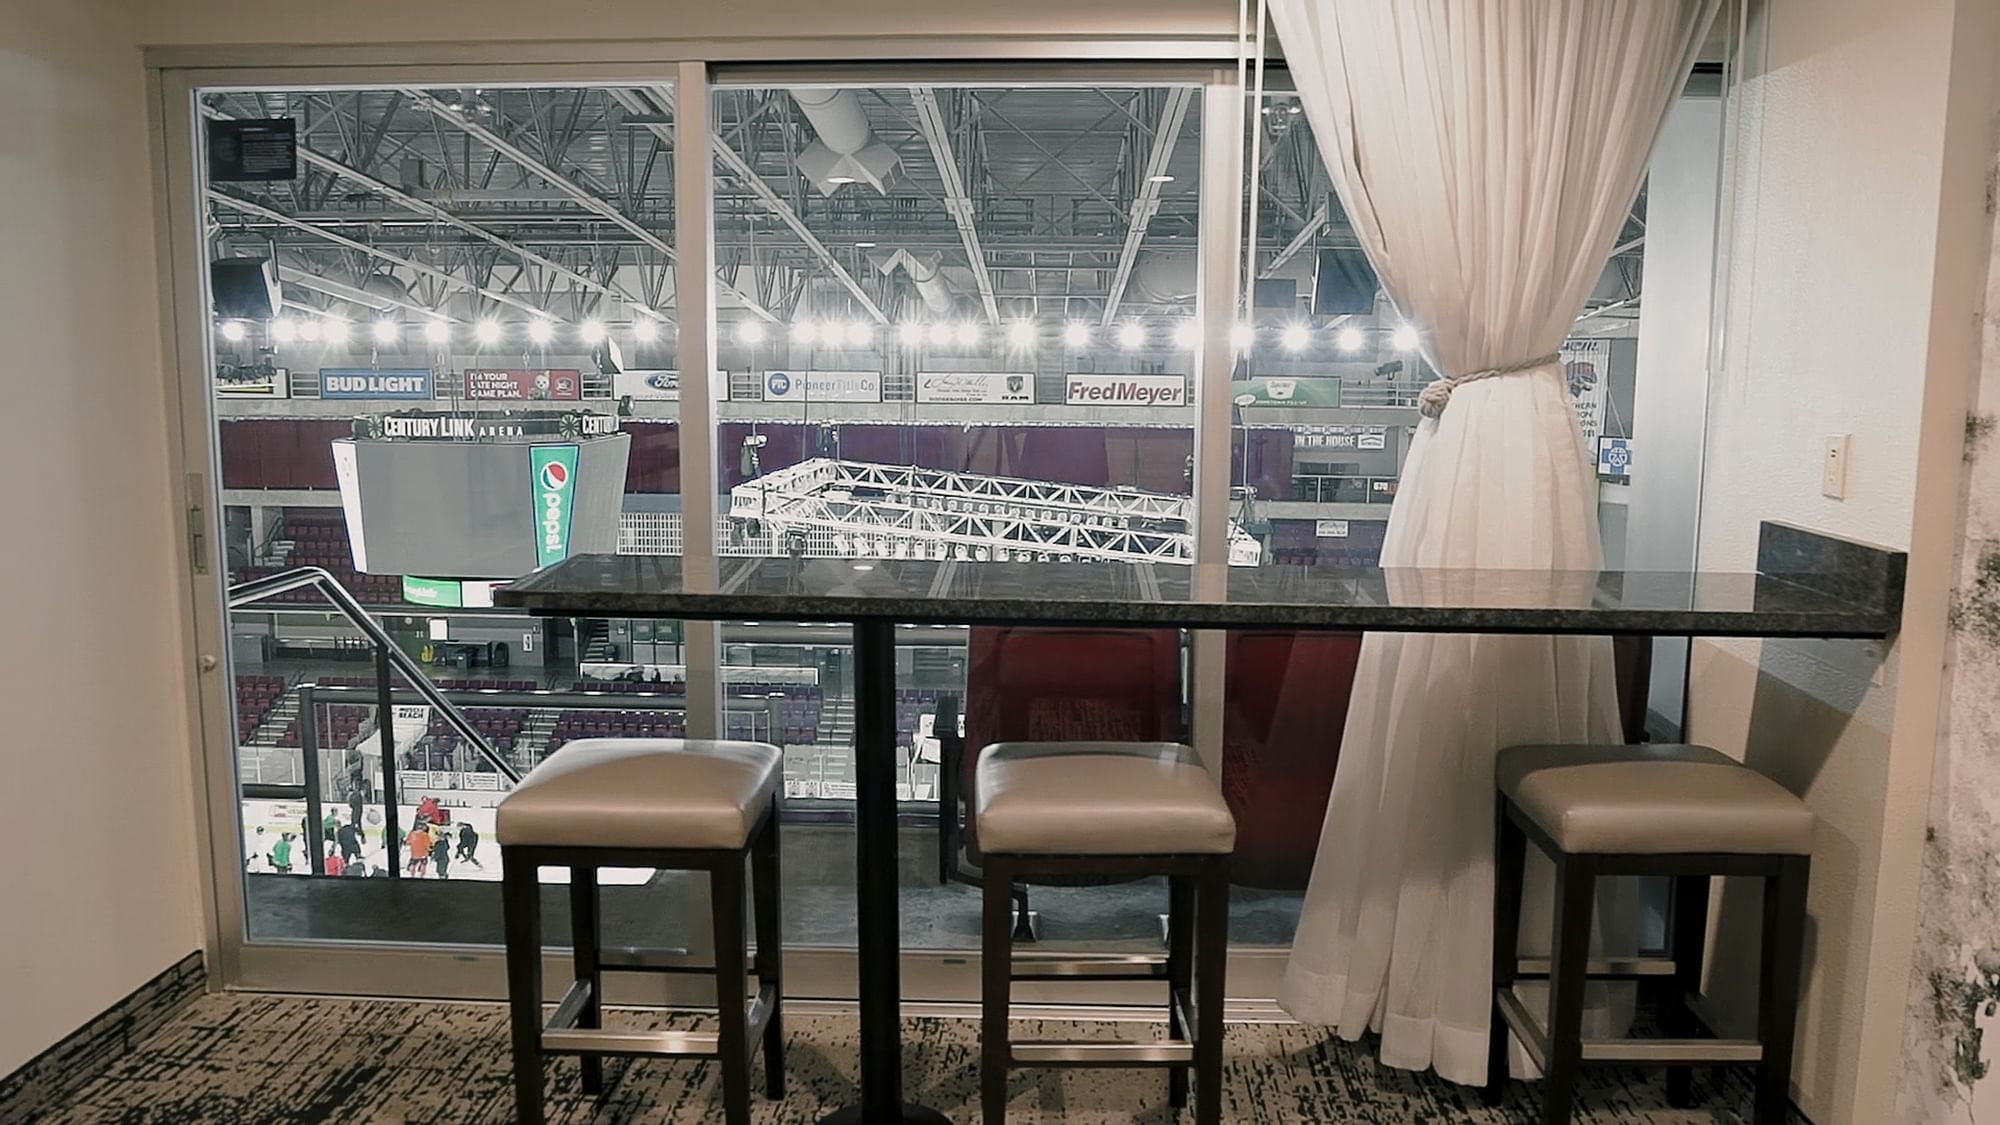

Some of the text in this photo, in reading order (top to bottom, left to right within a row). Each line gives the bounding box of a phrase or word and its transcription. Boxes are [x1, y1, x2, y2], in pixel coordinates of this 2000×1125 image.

[326, 376, 424, 392] BUD LIGHT
[654, 375, 680, 388] For
[480, 426, 523, 436] ARENA
[1307, 435, 1326, 448] THE
[1327, 435, 1356, 448] HOUSE
[543, 492, 562, 554] pepsi
